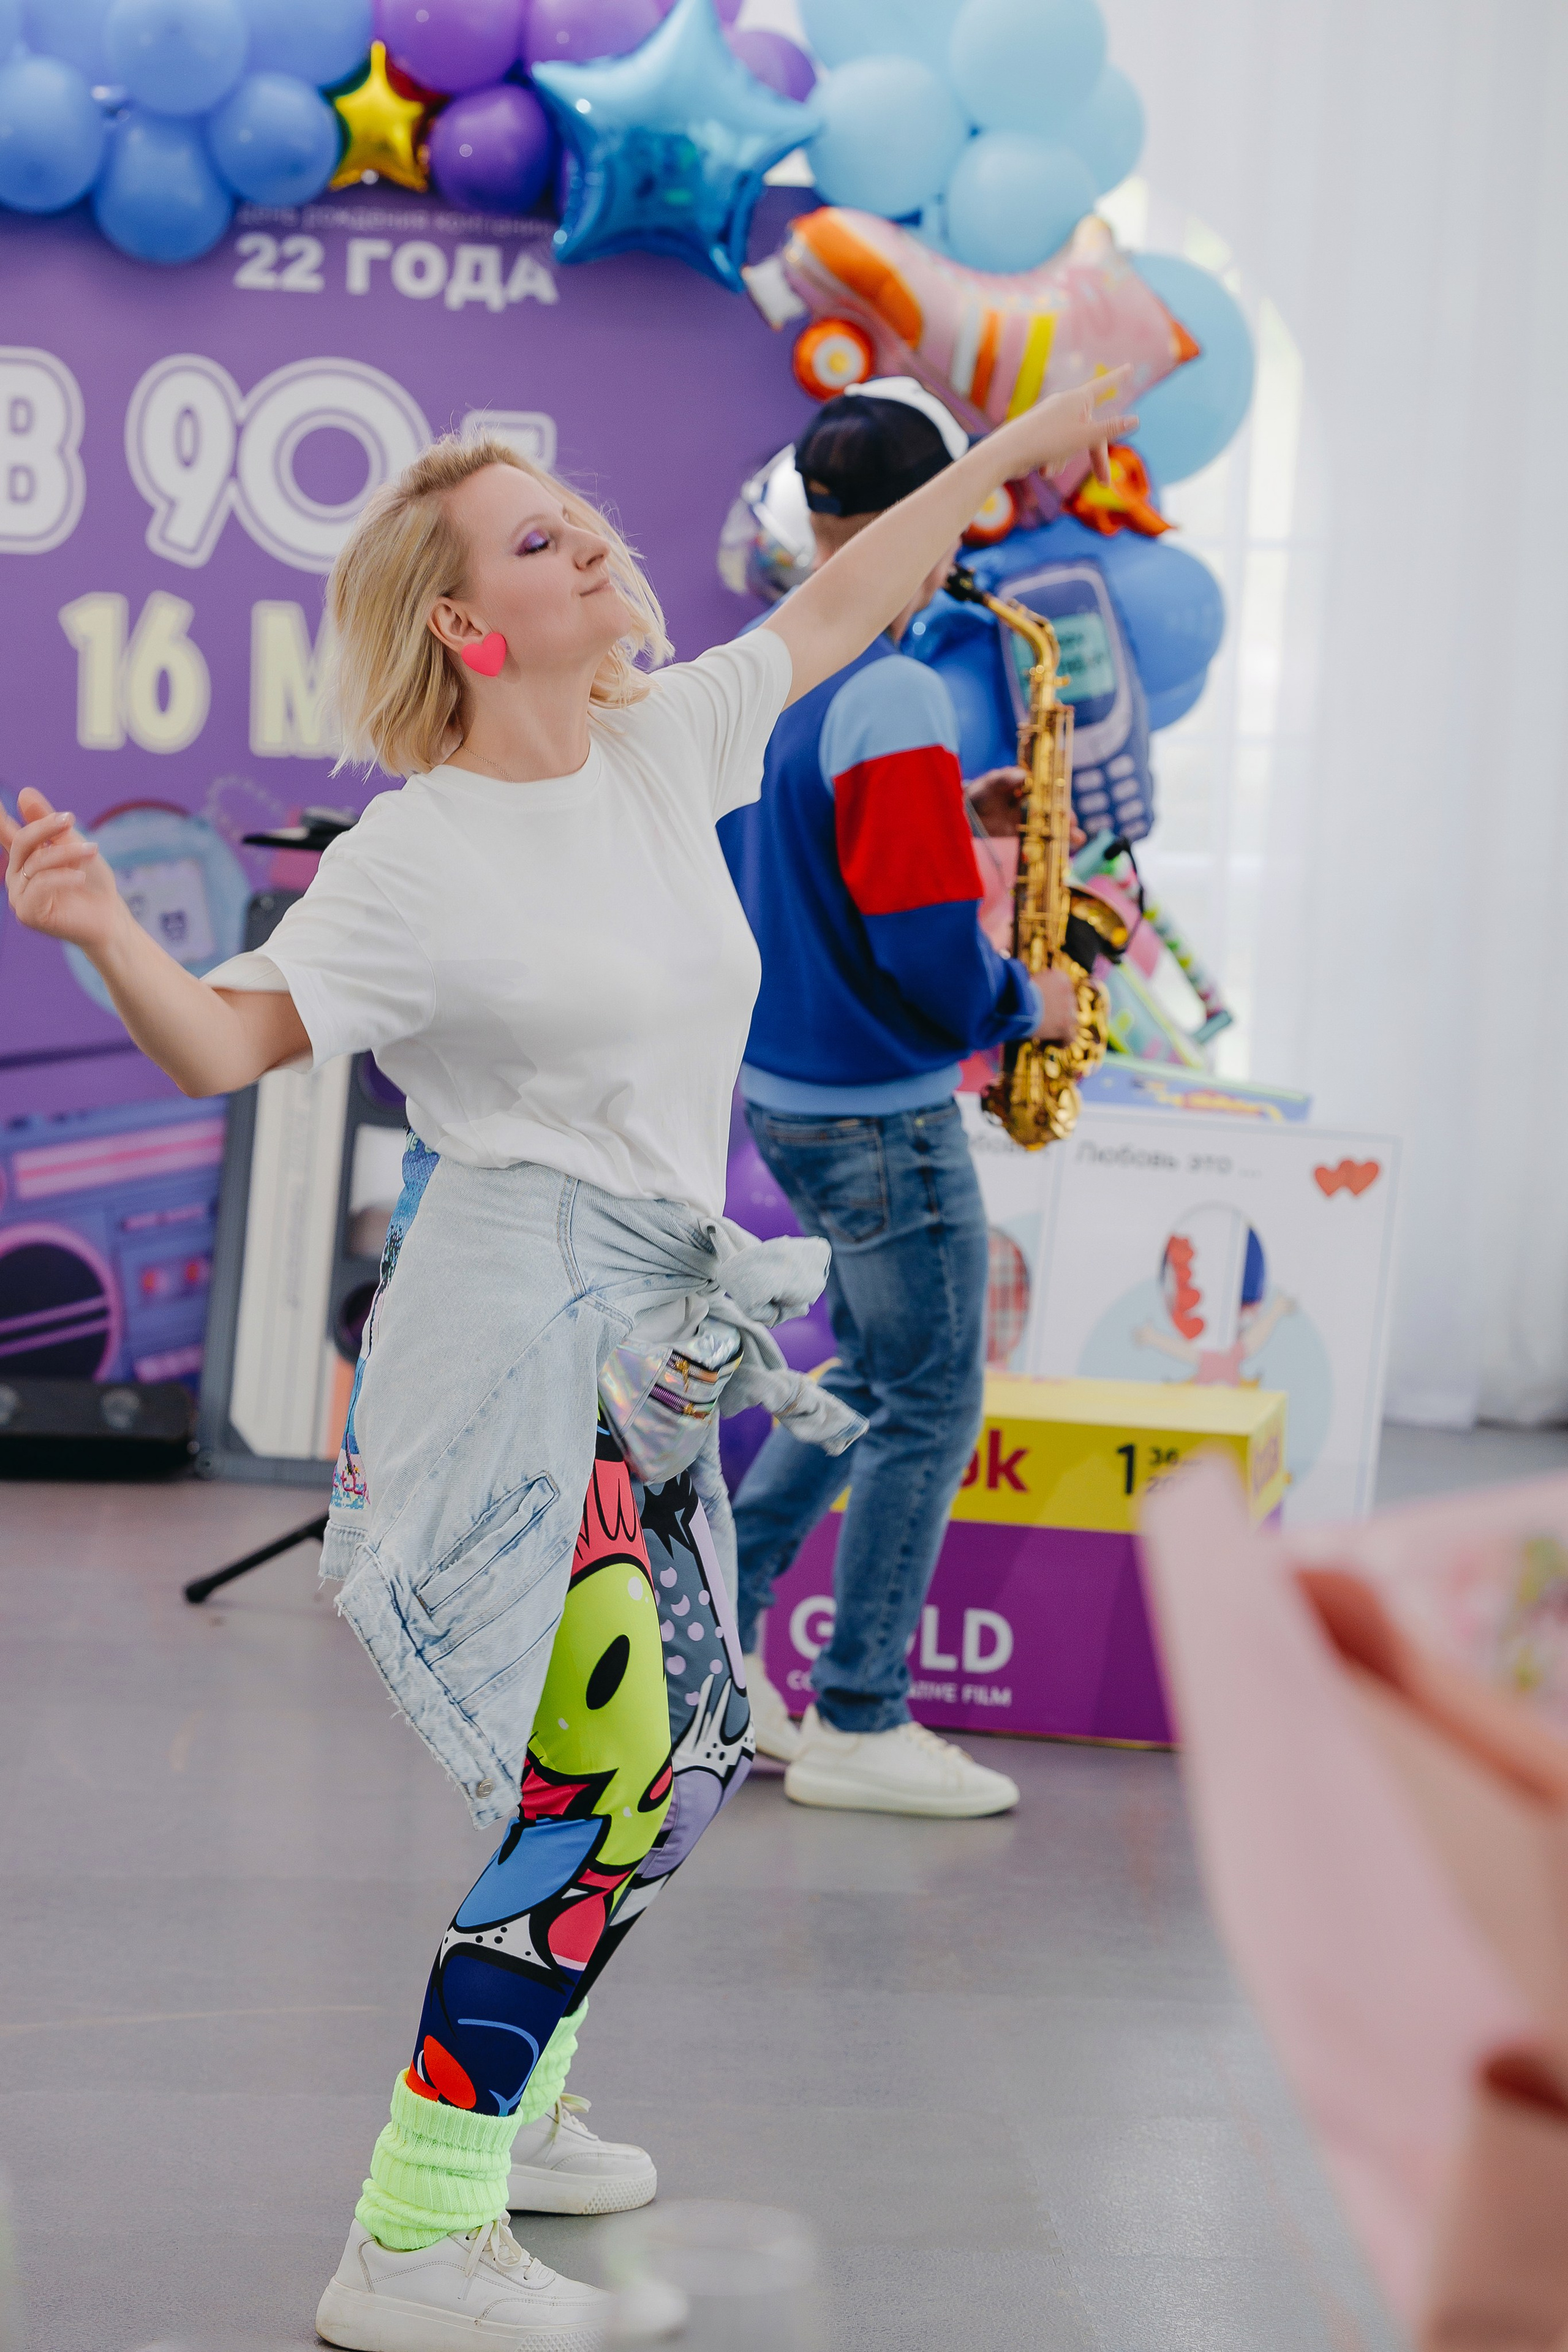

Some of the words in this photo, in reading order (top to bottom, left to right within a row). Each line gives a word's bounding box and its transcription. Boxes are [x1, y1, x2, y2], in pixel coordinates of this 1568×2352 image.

[234, 232, 325, 293] 22
[346, 238, 559, 312] ГОДА
[58, 590, 211, 754] 16
[1117, 1443, 1135, 1494] 1
[789, 1594, 1014, 1674] GLD
[962, 1683, 1012, 1708] FILM
